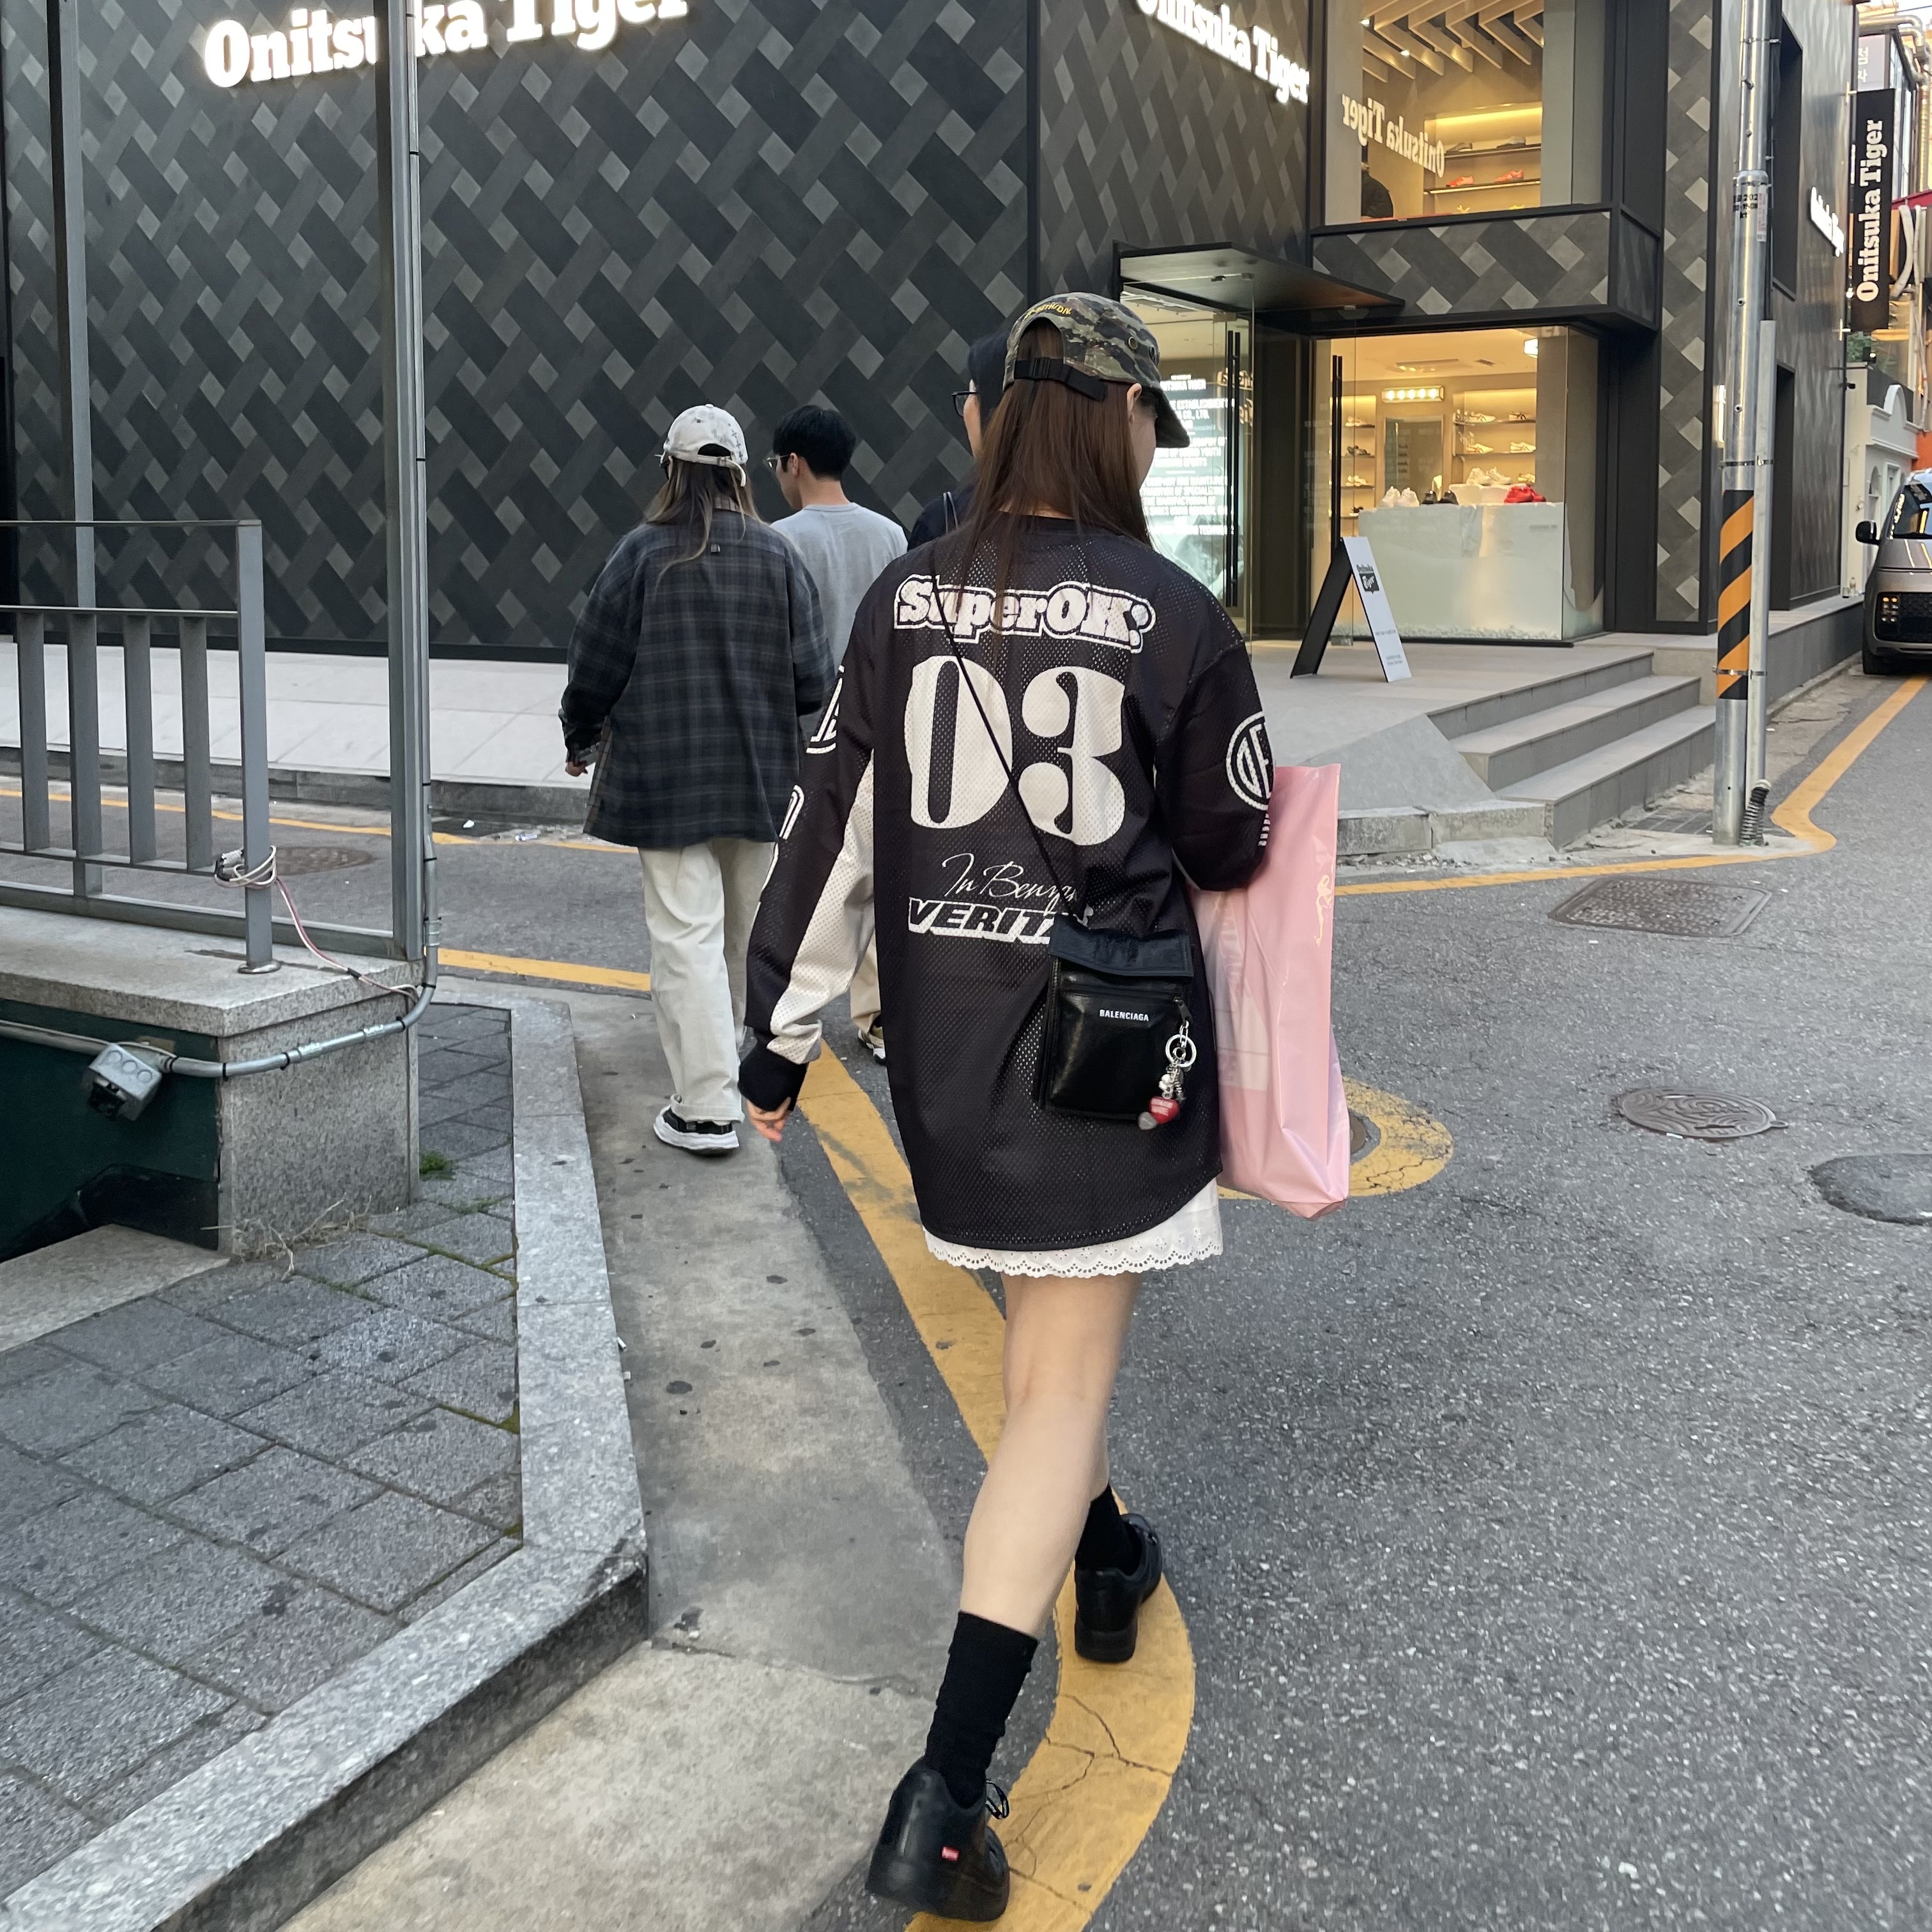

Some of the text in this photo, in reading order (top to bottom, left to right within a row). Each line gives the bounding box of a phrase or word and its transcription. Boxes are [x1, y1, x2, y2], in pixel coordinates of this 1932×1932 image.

[1137, 0, 1310, 105] nitsuka Tiger
[1856, 119, 1887, 302] Onitsuka Tiger
[904, 656, 1125, 846] 03
[941, 852, 977, 897] In
[908, 896, 1093, 945] VERIT
[1099, 1009, 1149, 1022] BALENCIAGA
